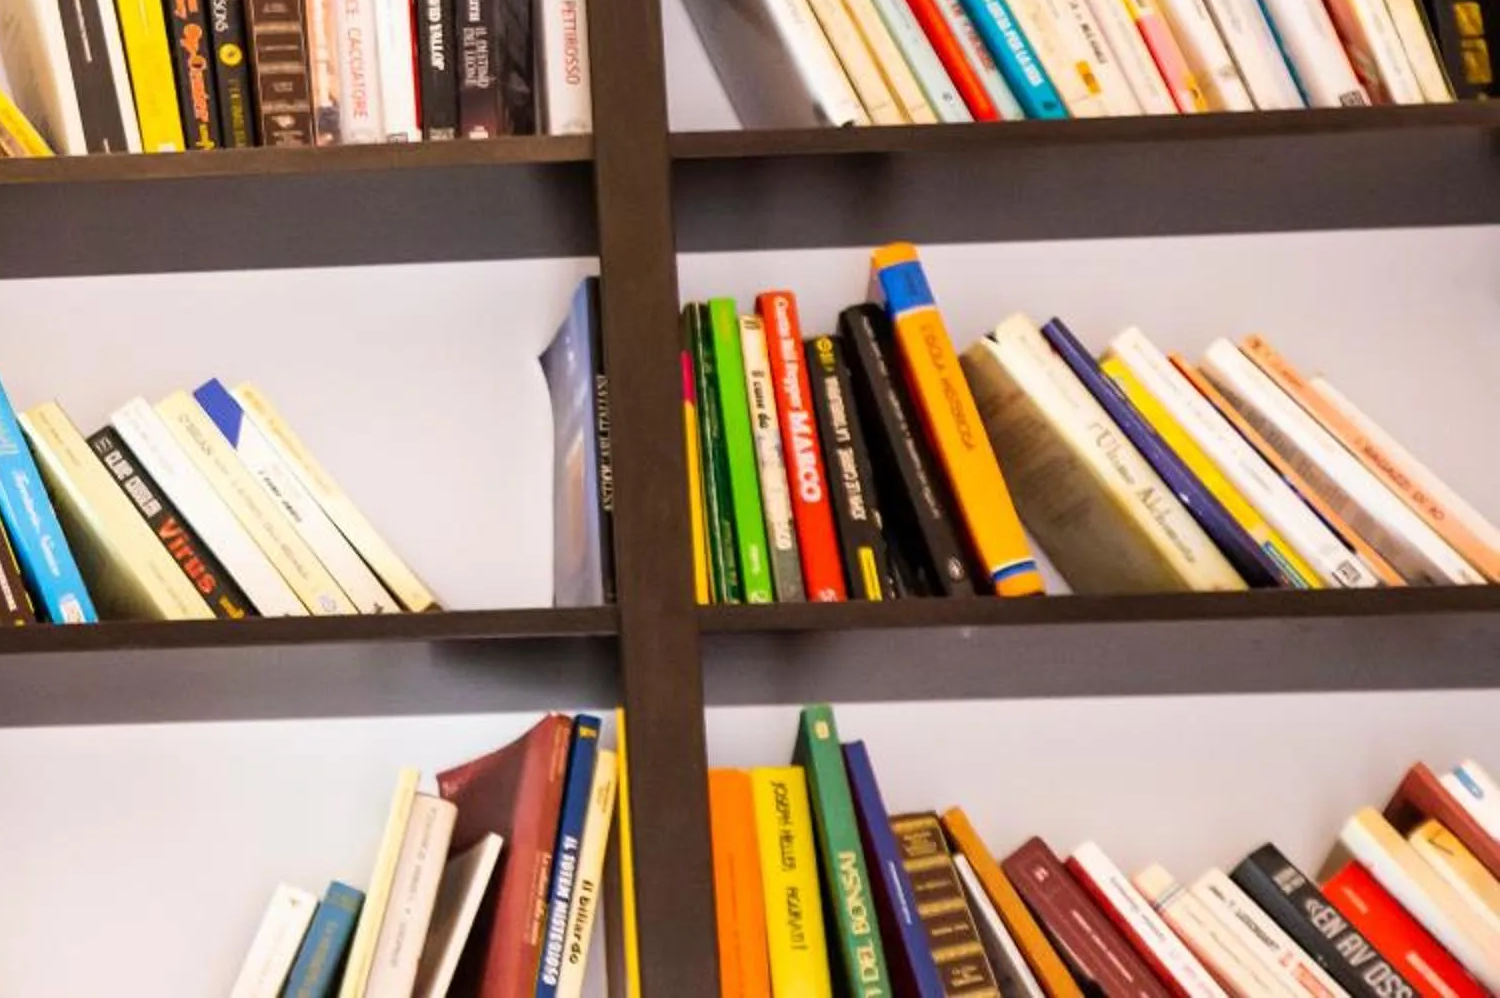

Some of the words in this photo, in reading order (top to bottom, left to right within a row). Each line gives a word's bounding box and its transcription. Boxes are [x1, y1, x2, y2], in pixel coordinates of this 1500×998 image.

[561, 0, 581, 86] PETTIROSSO
[786, 409, 822, 503] MARCO
[159, 518, 217, 595] Virus
[559, 853, 579, 897] TOTEM
[836, 850, 872, 935] BONSAI
[541, 899, 571, 986] MISTERIOSO
[568, 894, 590, 965] biliardo
